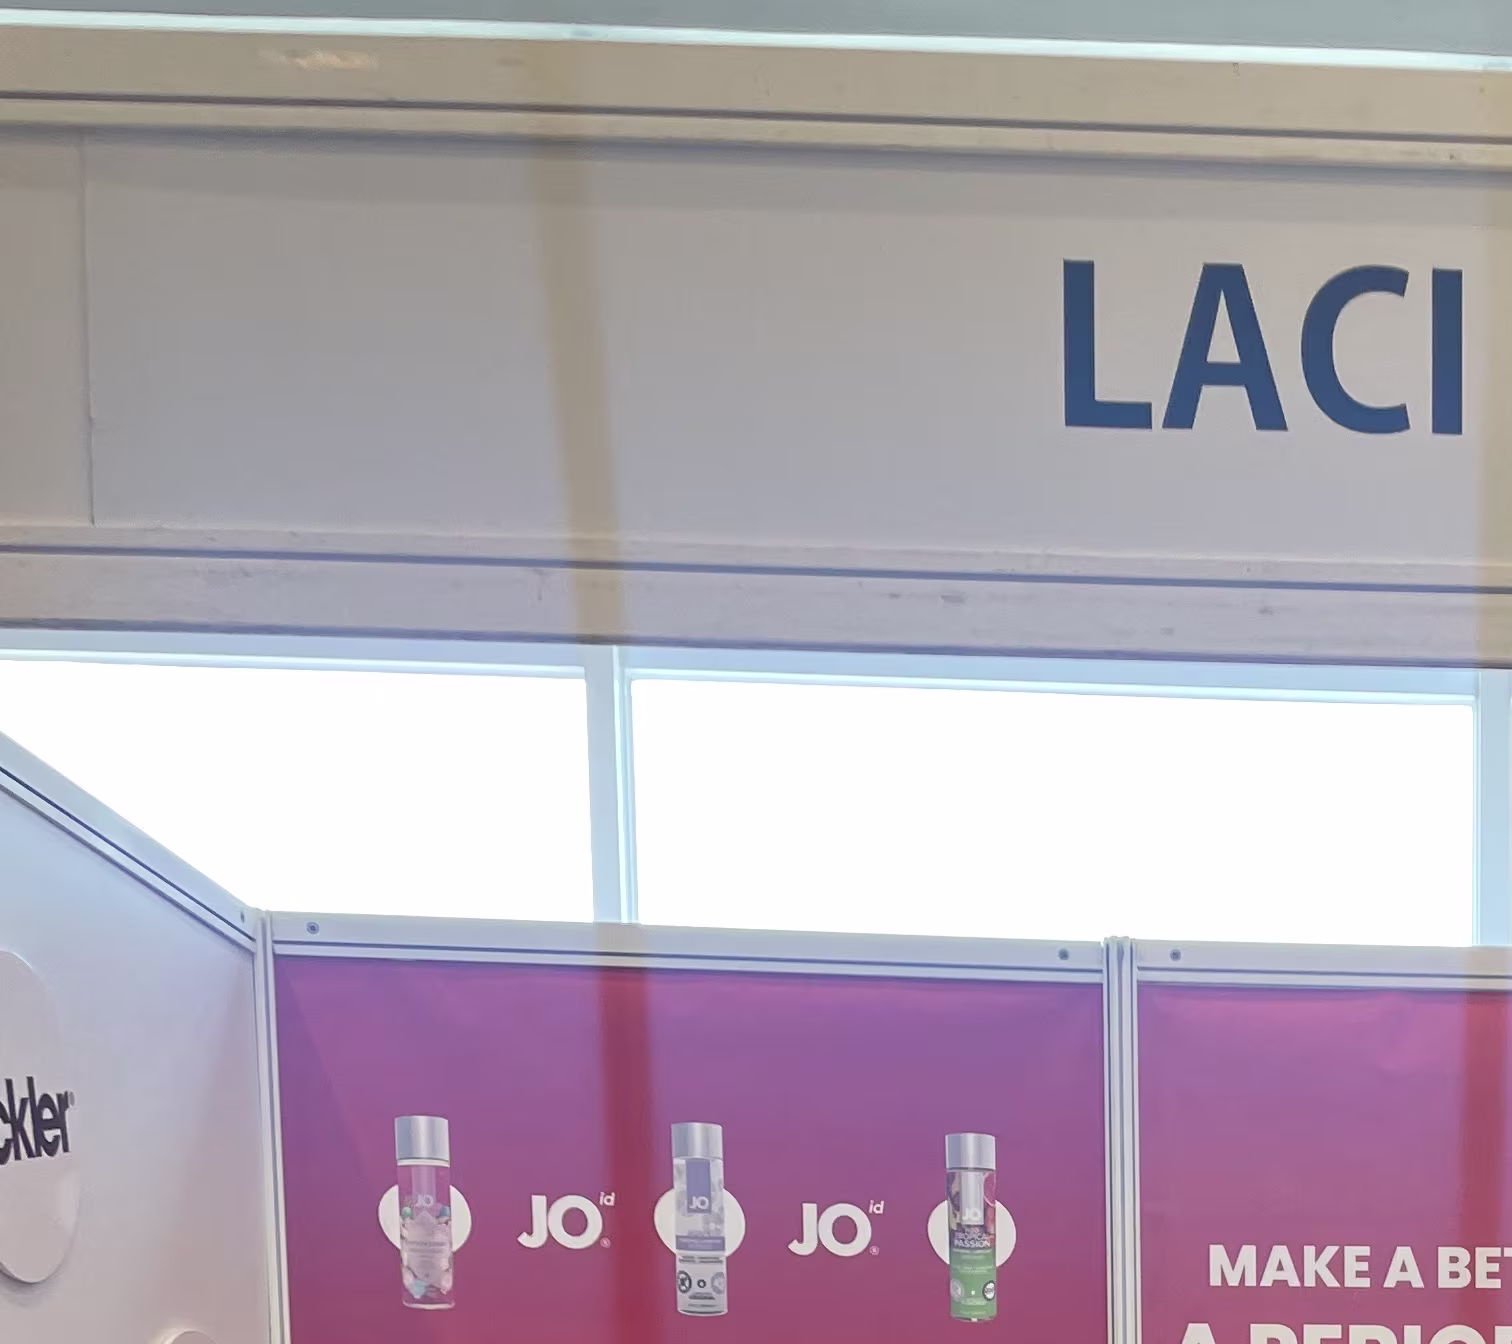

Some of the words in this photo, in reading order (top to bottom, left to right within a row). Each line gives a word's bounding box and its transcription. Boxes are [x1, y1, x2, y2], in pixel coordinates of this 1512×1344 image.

[1062, 258, 1463, 436] LACI
[518, 1195, 602, 1249] JO
[789, 1203, 871, 1256] JO
[1209, 1244, 1371, 1288] MAKE
[1383, 1245, 1423, 1289] A
